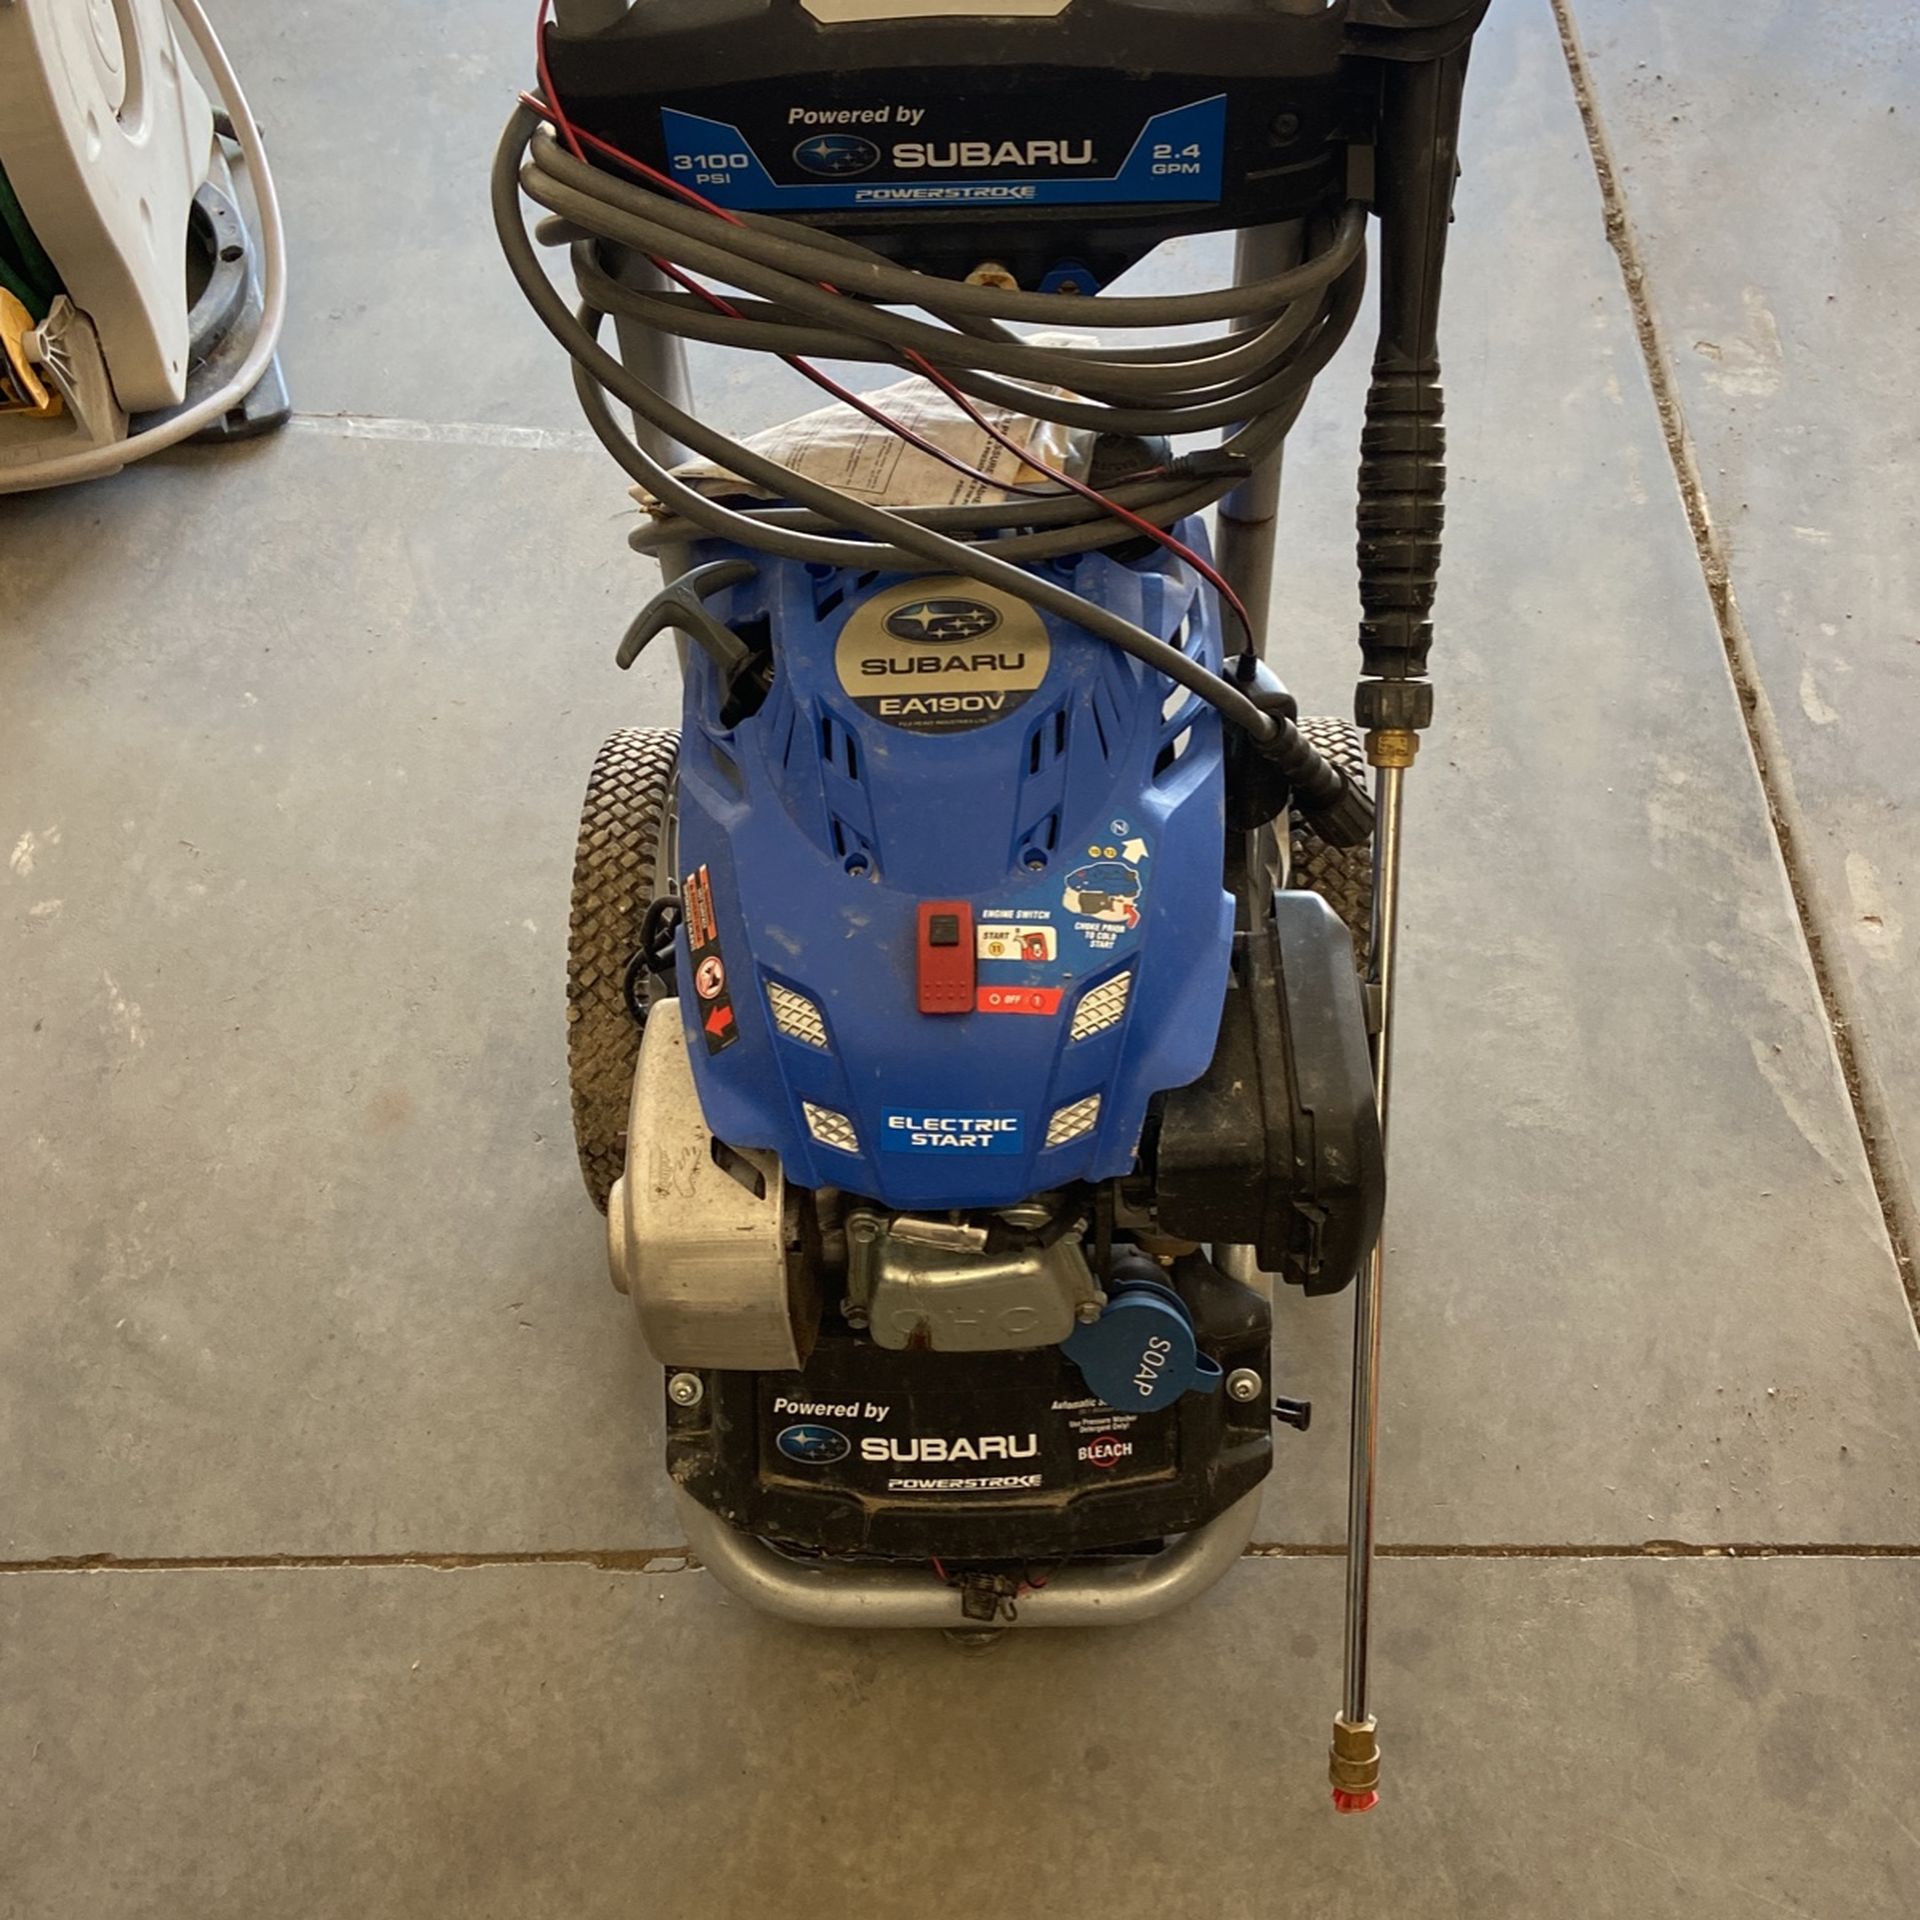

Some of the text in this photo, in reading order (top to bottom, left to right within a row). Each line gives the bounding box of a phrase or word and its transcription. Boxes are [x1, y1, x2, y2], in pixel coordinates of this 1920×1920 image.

[788, 106, 925, 126] Powered by
[892, 139, 1092, 169] SUBARU
[1152, 143, 1200, 160] 2.4
[673, 152, 749, 171] 3100
[1151, 162, 1200, 176] GPM
[695, 172, 731, 186] PSI
[856, 186, 1036, 202] POWERSTROKE
[861, 653, 1024, 675] SUBARU
[879, 696, 1005, 715] EA190V
[982, 909, 1051, 920] ENGINE SWITCH
[983, 931, 1010, 940] START
[1003, 994, 1022, 1004] OFF
[888, 1115, 1018, 1132] ELECTRIC
[911, 1132, 994, 1147] START
[1133, 1335, 1172, 1397] SOAP
[773, 1398, 890, 1422] Powered by
[861, 1434, 1038, 1462] SUBARU
[1077, 1441, 1133, 1461] BLEACH
[888, 1474, 1043, 1491] POWERSTROKE
